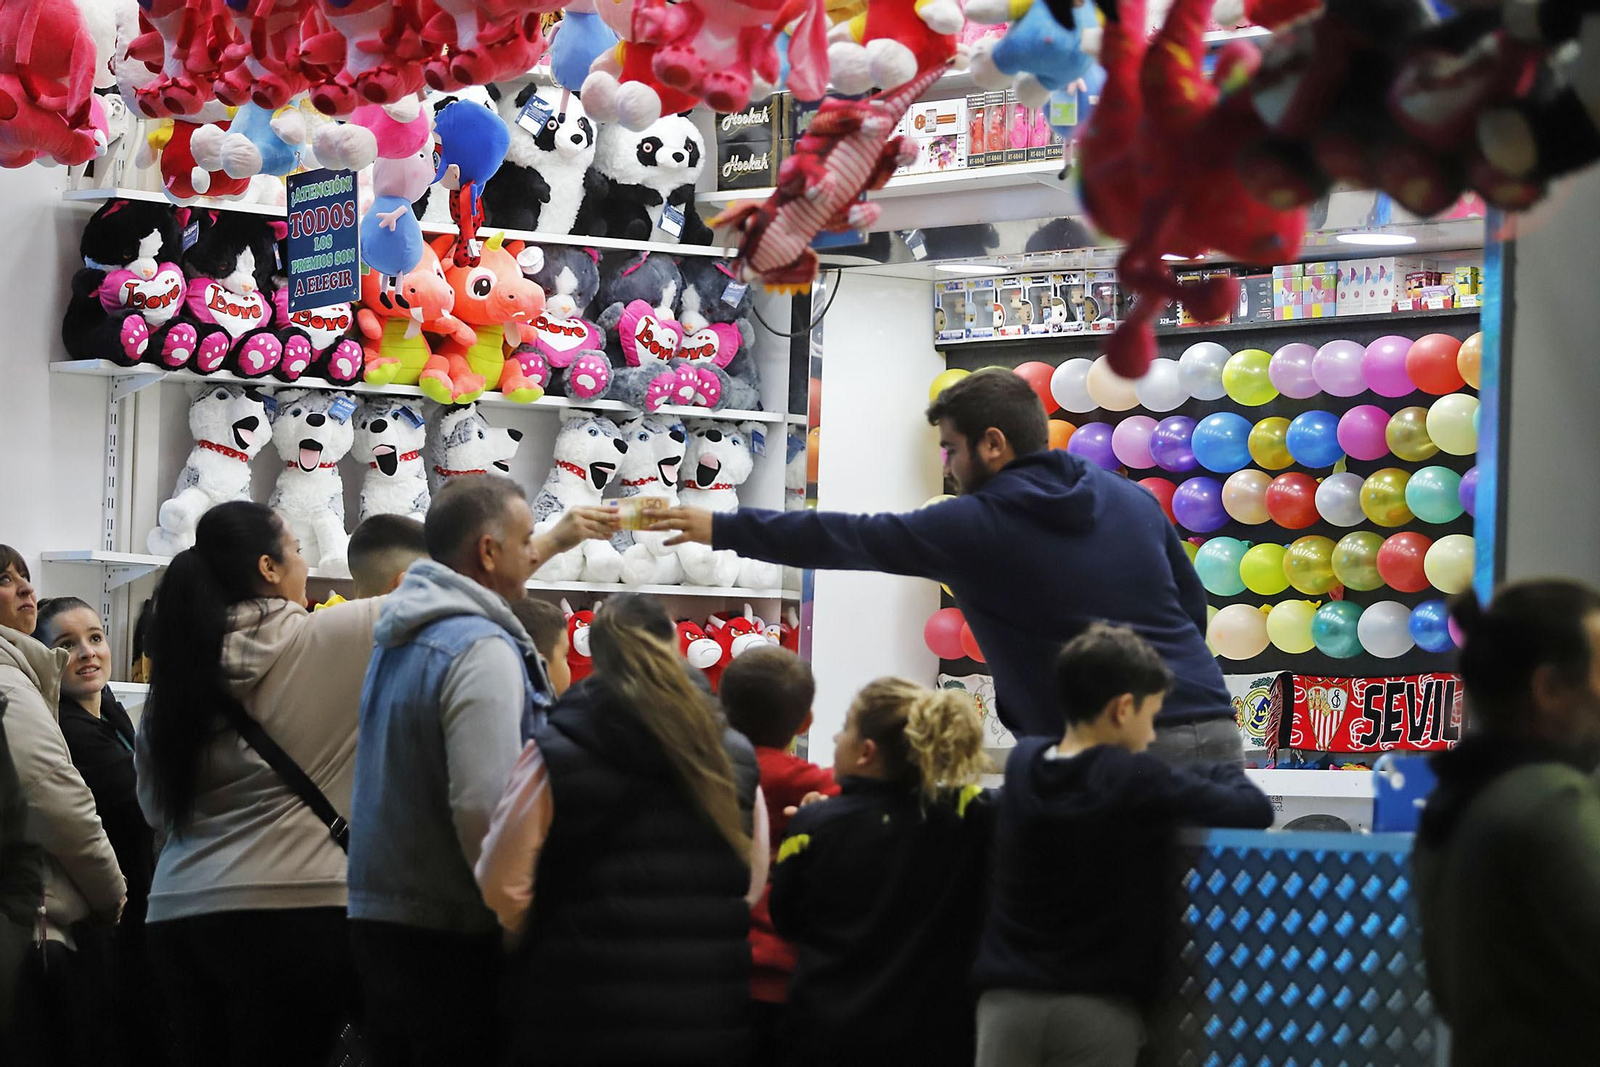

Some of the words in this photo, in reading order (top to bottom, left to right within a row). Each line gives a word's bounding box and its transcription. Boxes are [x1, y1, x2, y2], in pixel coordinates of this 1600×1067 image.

[721, 106, 769, 131] Hookah
[722, 153, 769, 177] Hookah
[291, 174, 353, 207] ¡ATENCIÓN!
[289, 200, 355, 239] TODOS
[313, 234, 333, 251] LOS
[291, 252, 333, 274] PREMIOS
[334, 247, 355, 266] SON
[124, 282, 181, 310] Love
[294, 279, 305, 297] A
[307, 270, 353, 294] ELEGIR
[208, 284, 263, 320] Love
[635, 316, 674, 361] Lov
